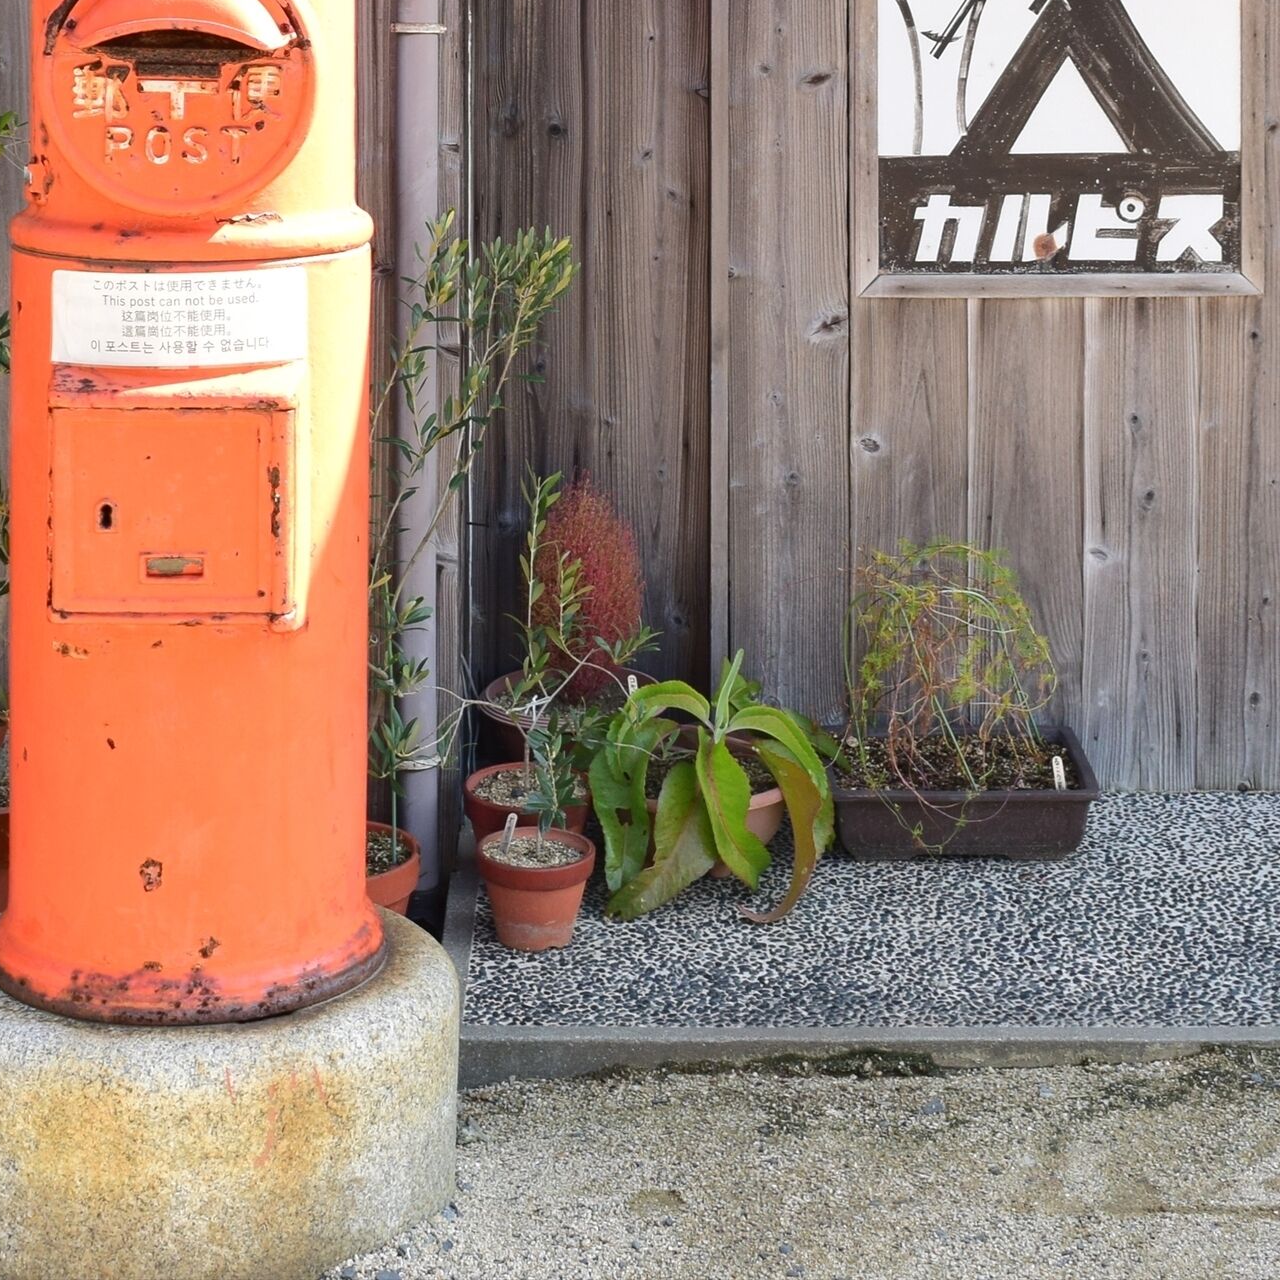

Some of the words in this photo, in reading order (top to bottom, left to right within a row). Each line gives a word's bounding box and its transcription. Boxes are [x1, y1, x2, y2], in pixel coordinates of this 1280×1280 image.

[104, 124, 252, 165] POST
[914, 190, 1224, 263] カルピス
[93, 278, 262, 293] このポストは使用できません。
[102, 294, 126, 307] This
[130, 296, 156, 308] post
[159, 297, 181, 307] can
[185, 295, 205, 306] not
[209, 294, 224, 306] be
[90, 339, 101, 353] 이
[105, 340, 155, 354] 포스트는
[159, 340, 198, 354] 사용할
[202, 340, 216, 353] 수
